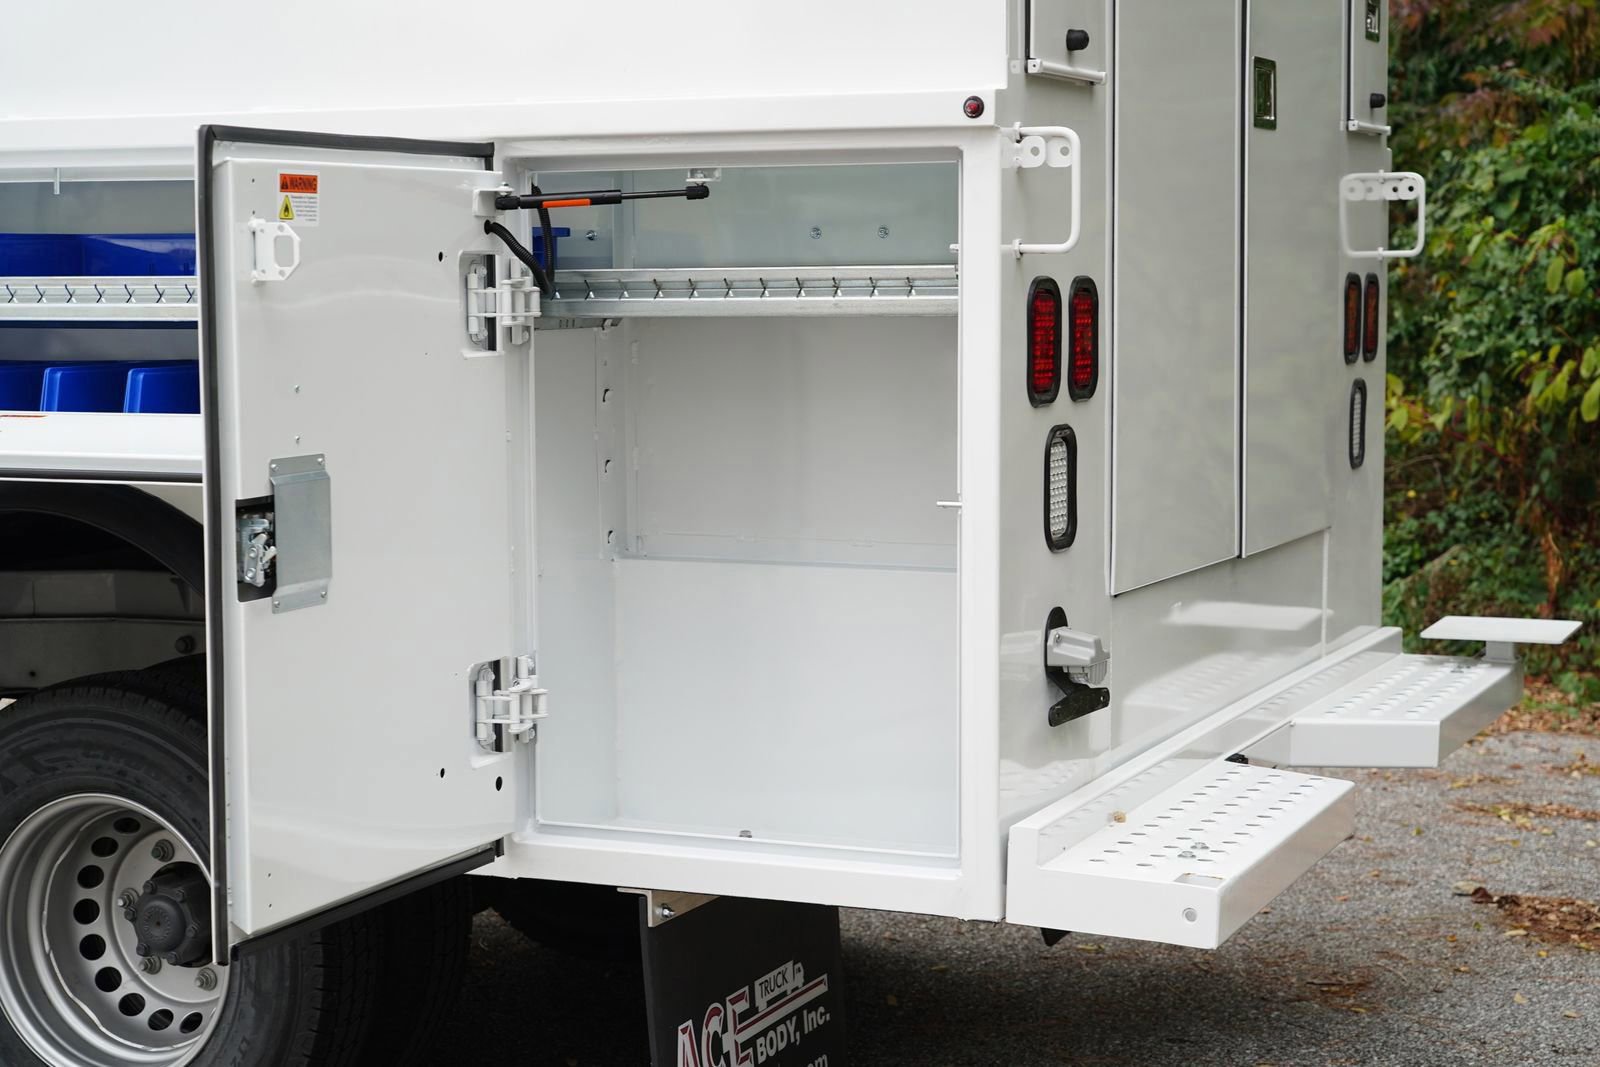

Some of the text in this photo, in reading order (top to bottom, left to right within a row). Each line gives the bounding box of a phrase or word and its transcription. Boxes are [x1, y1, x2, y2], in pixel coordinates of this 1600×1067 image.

[289, 176, 317, 191] WARNING
[758, 967, 788, 999] TRUCK
[756, 1006, 831, 1065] BODY, Inc.
